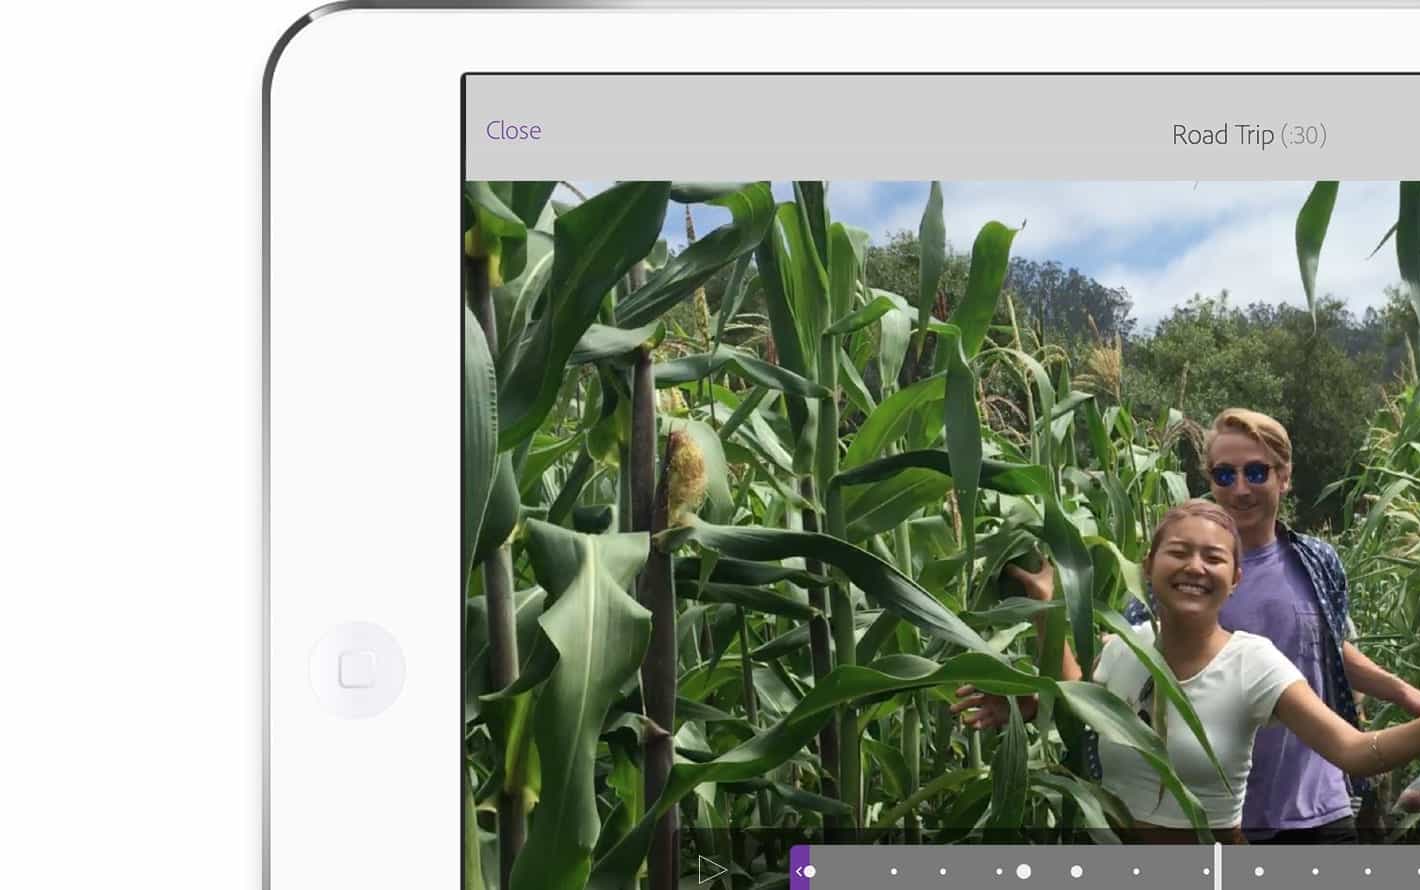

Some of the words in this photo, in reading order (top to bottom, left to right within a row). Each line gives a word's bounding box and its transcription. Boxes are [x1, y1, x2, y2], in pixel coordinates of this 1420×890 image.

[486, 119, 542, 140] Close
[1173, 122, 1228, 145] Road
[1233, 122, 1275, 152] Trip
[1280, 122, 1327, 149] (:30)
